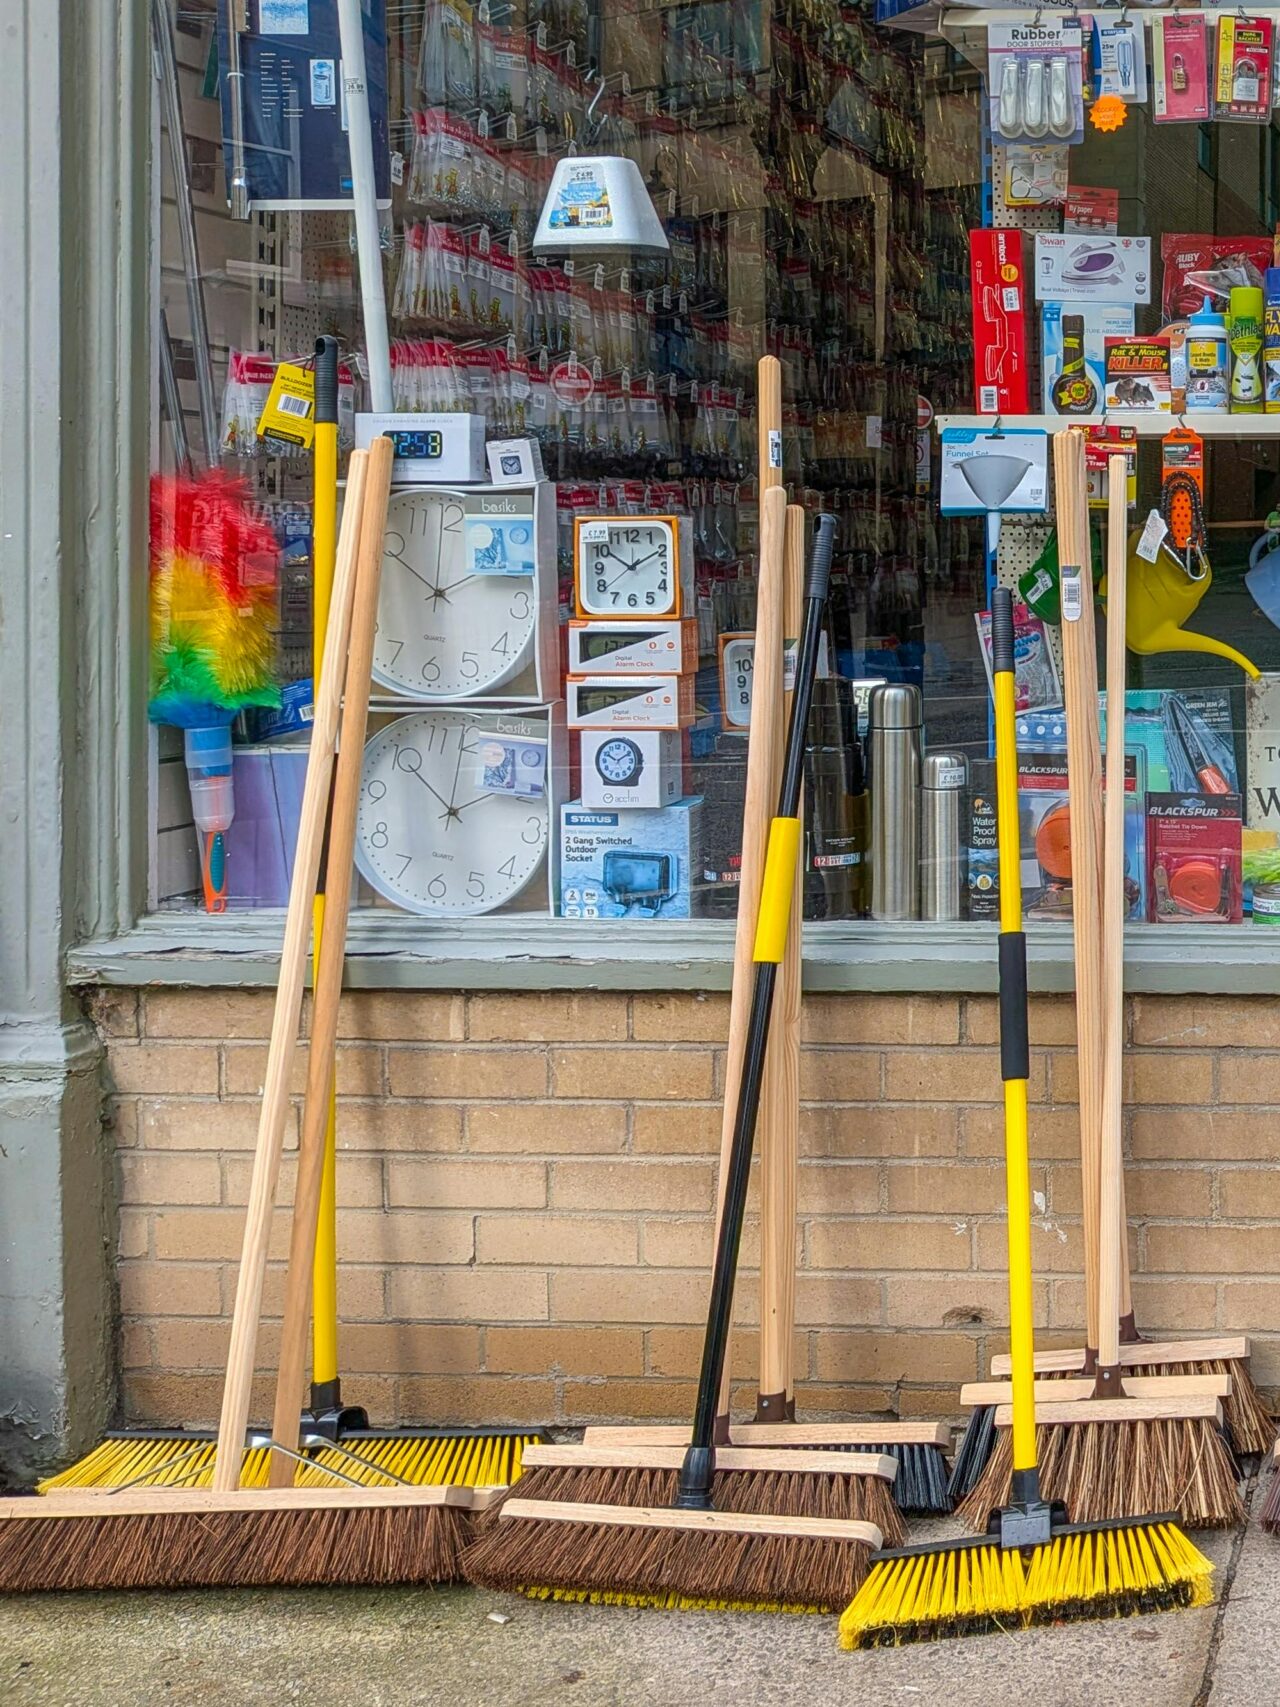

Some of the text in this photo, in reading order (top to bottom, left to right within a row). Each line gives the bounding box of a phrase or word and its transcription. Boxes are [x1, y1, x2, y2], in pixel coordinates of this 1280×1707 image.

[1011, 29, 1061, 40] Rubber
[1039, 235, 1066, 246] Swan
[1111, 348, 1167, 356] Rat & Mouse
[1108, 356, 1163, 370] KILLER
[280, 375, 313, 388] BULLDOZER
[946, 450, 974, 458] Funnel
[481, 498, 517, 513] basiks
[410, 507, 427, 537] 11
[438, 502, 465, 534] 12
[509, 591, 530, 620] 3
[423, 634, 447, 643] QUARTZ
[491, 631, 510, 657] 4
[387, 639, 405, 666] 7
[614, 655, 633, 663] Digital
[421, 656, 441, 682] 6
[459, 651, 480, 679] 5
[495, 717, 532, 736] basiks
[428, 725, 448, 755] 11
[391, 743, 423, 773] 10
[1018, 766, 1069, 775] BLACKSPUR
[367, 779, 387, 805] 9
[1148, 806, 1219, 817] BLACKSPUR
[570, 815, 613, 824] STATUS
[972, 816, 997, 827] Water
[370, 821, 389, 849] 8
[520, 816, 542, 845] 3
[973, 826, 996, 836] Proof
[565, 836, 633, 846] 2 Gang Switched
[972, 835, 997, 846] Spray
[431, 851, 454, 862] QUARTZ
[565, 845, 598, 854] Outdoor
[565, 854, 593, 863] Socket
[395, 853, 413, 879] 7
[496, 855, 517, 880] 4
[427, 873, 447, 899] 6
[465, 871, 485, 898] 5
[569, 890, 576, 898] 2
